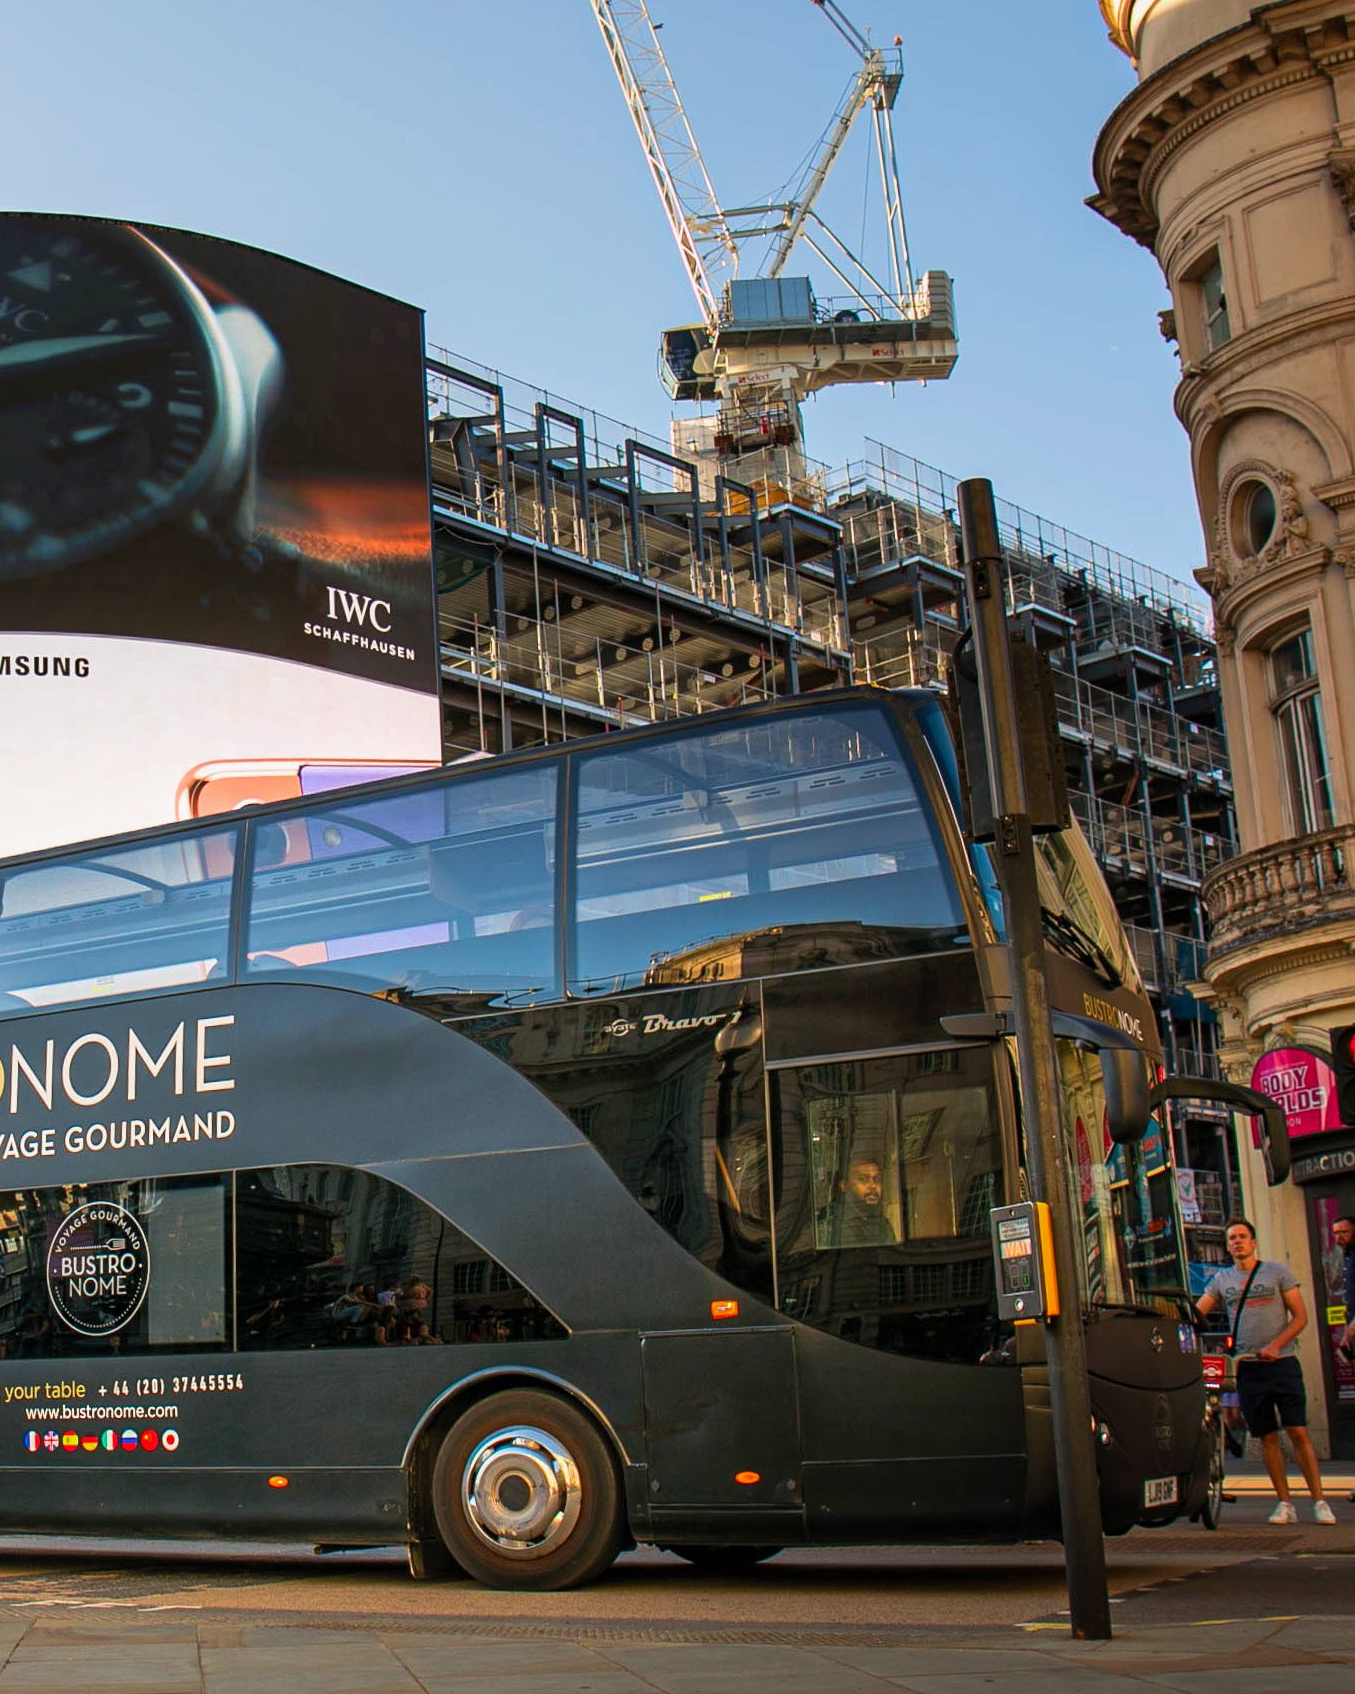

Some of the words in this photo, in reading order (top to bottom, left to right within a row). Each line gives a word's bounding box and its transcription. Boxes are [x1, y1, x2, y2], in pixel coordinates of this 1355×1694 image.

[746, 373, 770, 382] Select
[326, 586, 392, 632] IWC
[304, 622, 415, 661] SCHAFFHAUSEN
[642, 1013, 727, 1034] Bravo
[1082, 991, 1144, 1042] BUSTRONOME
[1260, 1065, 1308, 1096] BODY
[1272, 1086, 1328, 1115] RLDS
[64, 1110, 236, 1154] GOURMAND
[55, 1214, 88, 1253] VOYAGE
[90, 1210, 141, 1251] GOURMAND
[1004, 1241, 1029, 1257] WAIT
[61, 1253, 136, 1277] BUSTRO
[69, 1275, 128, 1298] NOME
[4, 1383, 40, 1402] your
[44, 1380, 86, 1399] table
[113, 1380, 130, 1396] 44
[136, 1378, 165, 1396] (20)
[172, 1374, 244, 1393] 37445554
[25, 1404, 178, 1420] www.bustronome.com
